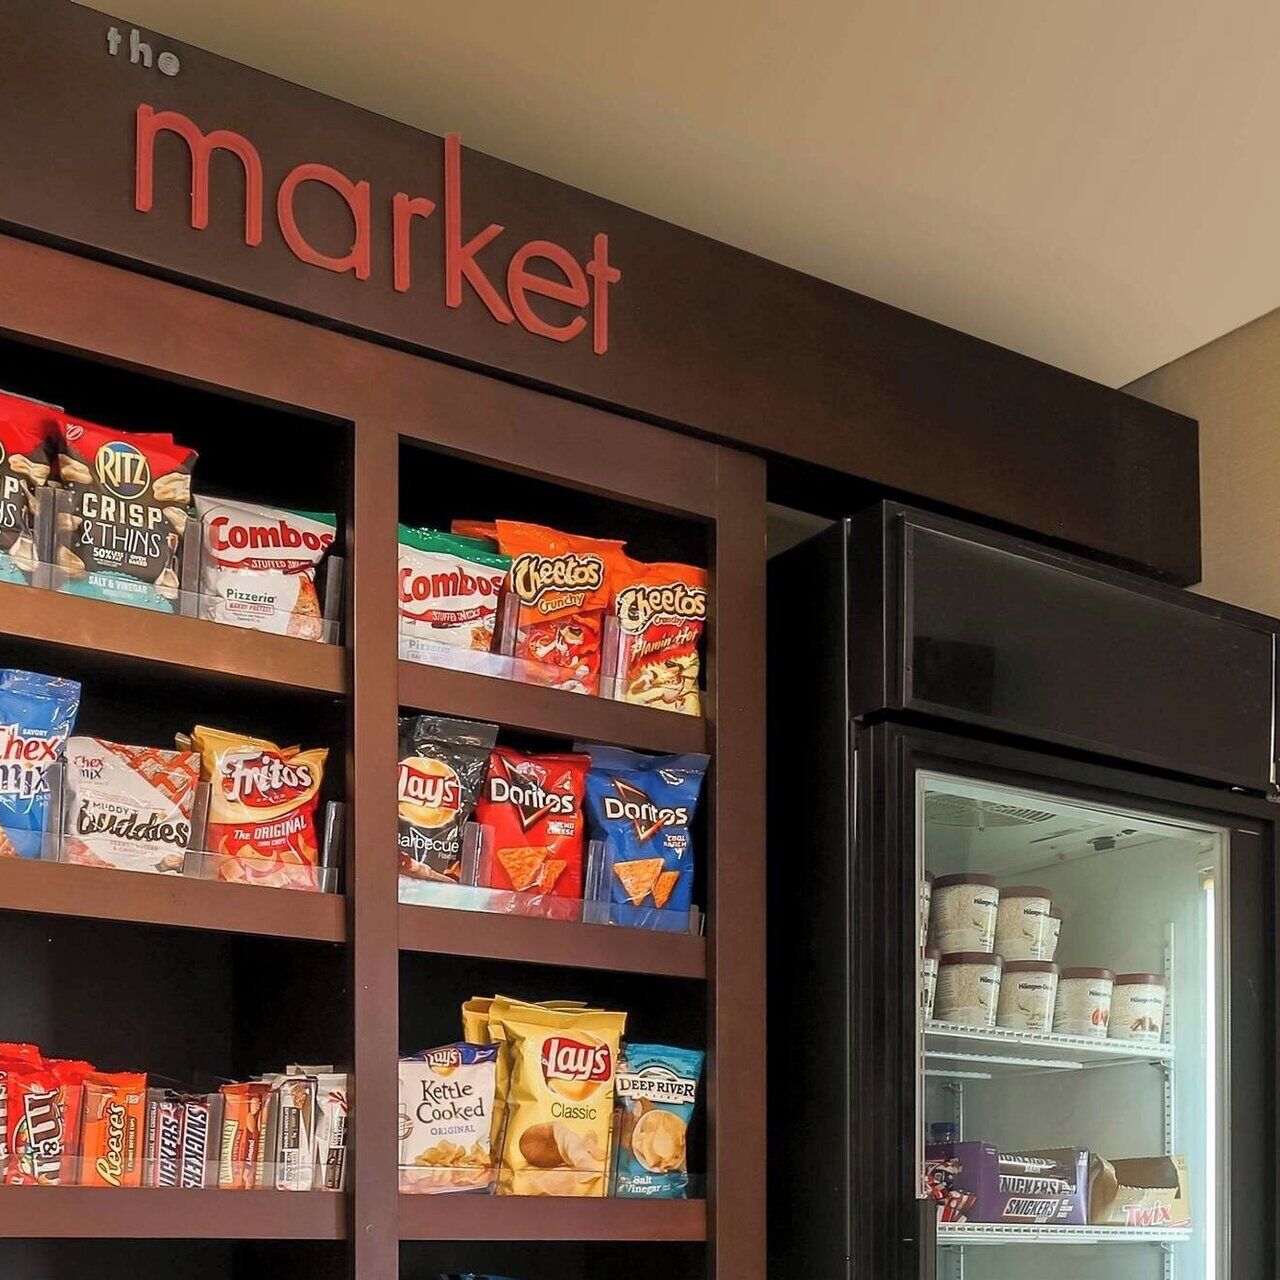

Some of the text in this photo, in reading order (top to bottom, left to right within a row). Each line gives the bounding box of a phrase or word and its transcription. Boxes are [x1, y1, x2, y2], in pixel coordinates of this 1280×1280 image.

[107, 26, 181, 77] the
[135, 103, 621, 355] market
[98, 446, 148, 487] RITZ
[82, 492, 163, 531] CRISP
[81, 522, 162, 559] & THINS
[208, 516, 334, 552] Combos
[93, 546, 113, 561] 50%
[251, 558, 287, 570] STUFFED
[88, 574, 149, 594] SALT VINEGAR
[399, 566, 502, 603] Combos
[513, 555, 604, 601] Cheetos
[226, 588, 276, 604] Pizzeria
[538, 592, 585, 614] Crunchy
[432, 610, 458, 622] STUFFED
[619, 586, 707, 630] Cheetos
[652, 615, 685, 627] Crunchy
[22, 728, 48, 737] SAVORY
[72, 756, 104, 769] Chex
[80, 767, 103, 780] mix
[220, 751, 313, 803] Fritos
[399, 763, 461, 809] Lay's
[490, 776, 574, 815] Doritos
[92, 801, 131, 815] MUDDY
[604, 797, 688, 827] Doritos
[78, 799, 190, 848] buddies
[233, 816, 307, 840] The ORIGINAL
[546, 827, 576, 836] CHEESE
[398, 831, 460, 853] Barbecue
[663, 840, 688, 848] RANCH
[665, 833, 687, 842] COOL
[428, 1049, 459, 1069] Lay's
[545, 1038, 610, 1082] Lay's
[420, 1079, 475, 1104] Kettle
[619, 1078, 695, 1097] DEEP RIVER
[416, 1097, 486, 1124] Cooked
[550, 1101, 598, 1121] Classic
[430, 1124, 477, 1136] ORIGINAL
[95, 1103, 127, 1187] Reese's
[632, 1174, 654, 1186] Salt
[1004, 1199, 1059, 1217] SNICKERS
[1122, 1200, 1173, 1228] Twix
